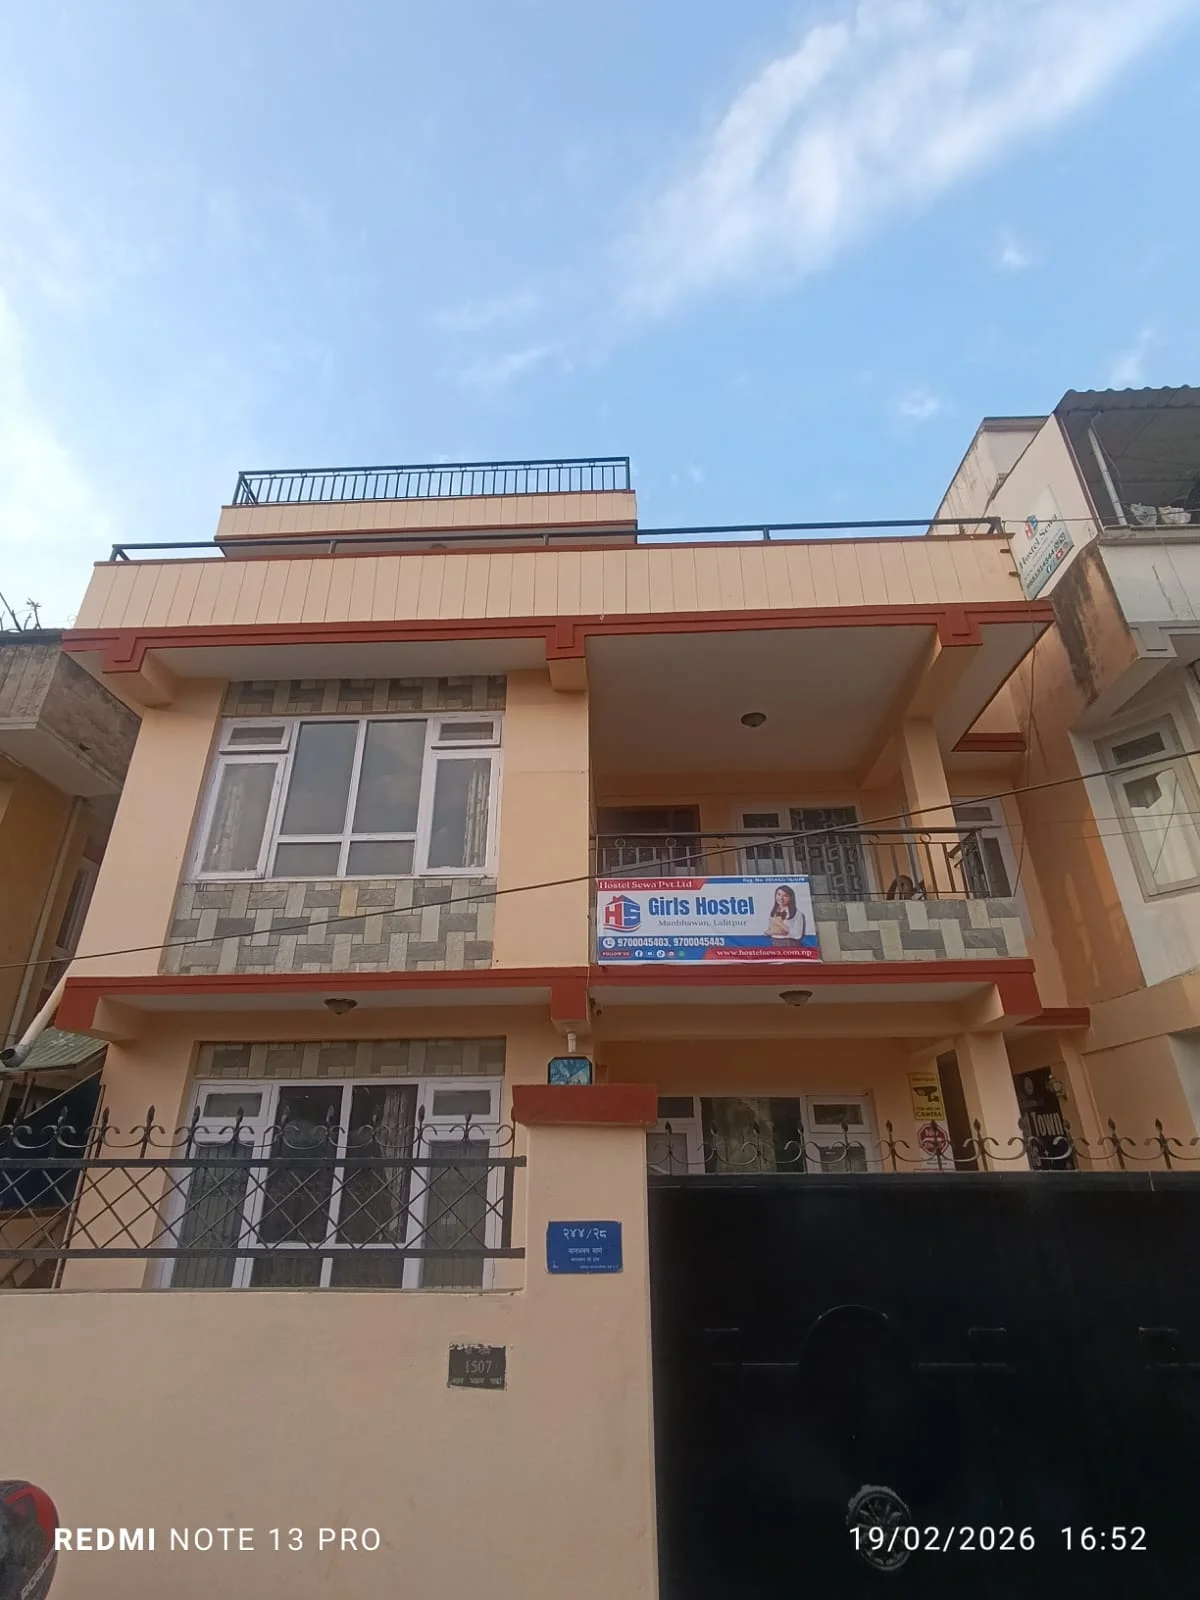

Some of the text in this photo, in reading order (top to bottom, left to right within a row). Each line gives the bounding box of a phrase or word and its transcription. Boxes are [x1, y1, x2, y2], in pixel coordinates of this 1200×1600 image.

[1019, 538, 1041, 569] Hostel
[599, 881, 630, 889] Hostel
[631, 881, 657, 889] Sewa
[648, 896, 755, 915] Girls Hostel
[713, 919, 747, 928] Lalitpur
[673, 937, 725, 946] 9700045443
[717, 949, 812, 957] www.hostelsewa.com.np
[563, 1228, 607, 1240] २४४/२८
[465, 1360, 493, 1373] 1507
